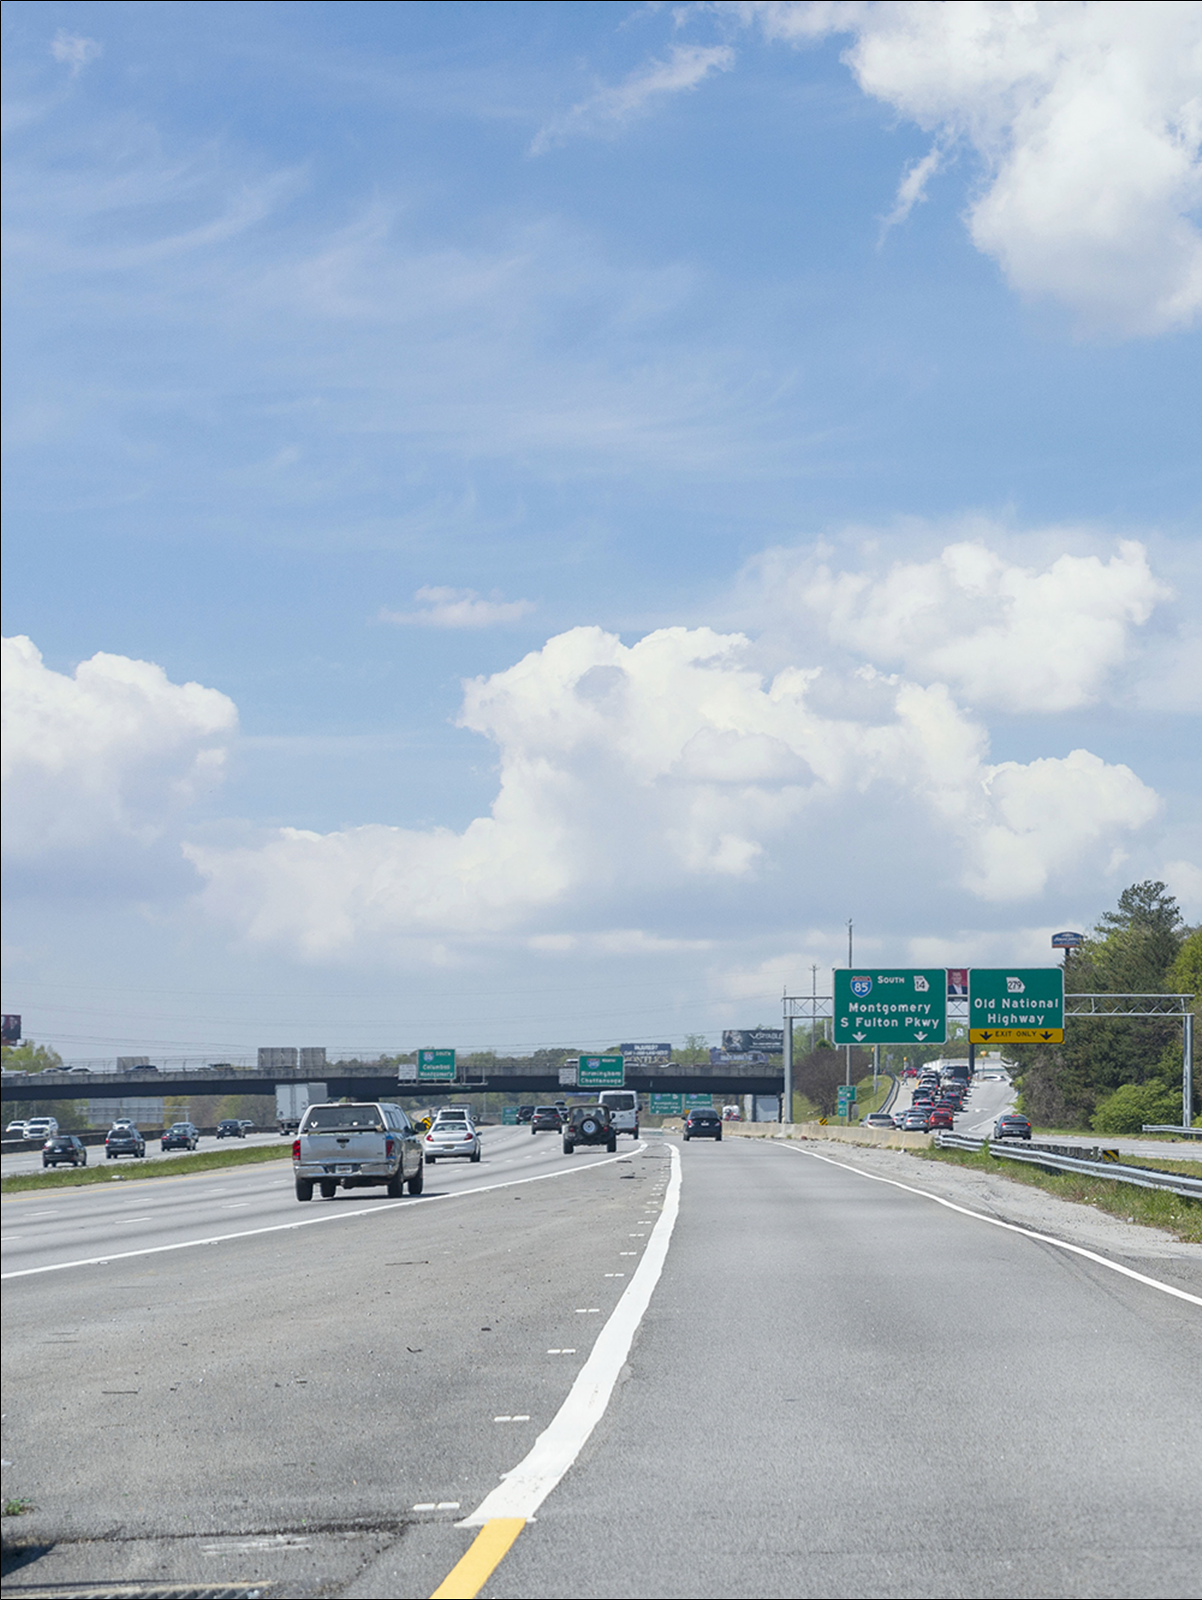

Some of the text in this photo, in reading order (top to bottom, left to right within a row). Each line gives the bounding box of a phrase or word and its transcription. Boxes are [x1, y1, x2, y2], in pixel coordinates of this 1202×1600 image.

[877, 975, 905, 984] SOUTH
[915, 980, 925, 989] 14
[1008, 980, 1022, 990] 279
[854, 982, 869, 993] 85
[848, 1002, 931, 1015] Montgomery
[974, 998, 1058, 1009] Old National
[840, 1017, 940, 1029] S Fulton Pkwy
[987, 1013, 1045, 1026] Highway
